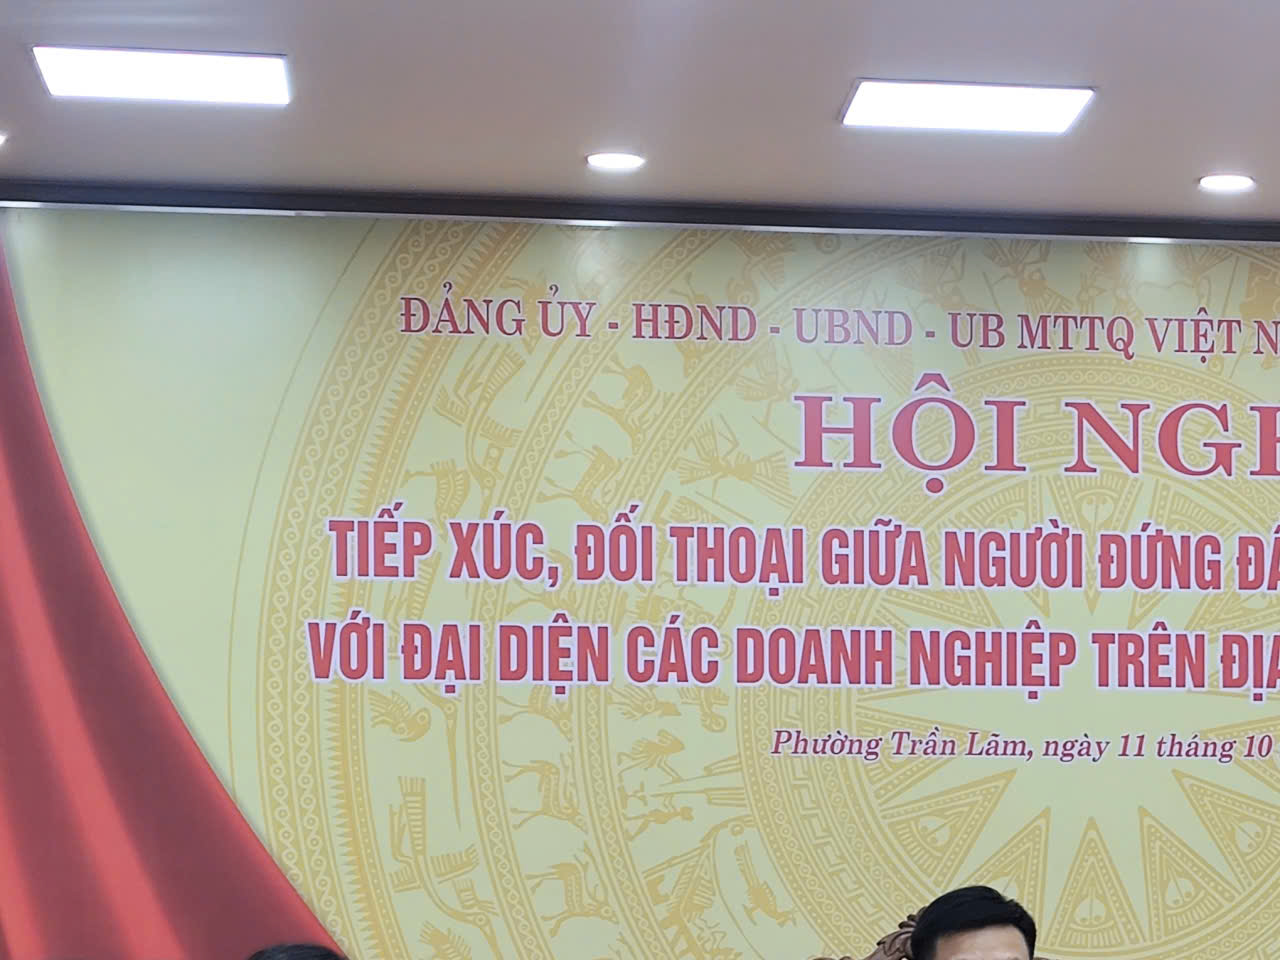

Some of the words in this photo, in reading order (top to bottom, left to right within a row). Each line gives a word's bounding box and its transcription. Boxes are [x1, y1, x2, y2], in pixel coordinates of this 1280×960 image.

[400, 284, 525, 338] ĐẢNG
[538, 285, 597, 339] ỦY
[632, 303, 759, 343] HĐND
[792, 308, 914, 347] UBND
[948, 312, 1006, 350] UB
[1017, 314, 1136, 360] MTTQ
[1144, 307, 1242, 364] VIỆT
[793, 372, 1026, 495] HỘI
[328, 502, 432, 578] TIẾP
[448, 511, 559, 588] XÚC,
[574, 504, 655, 583] ĐỐI
[670, 526, 802, 597] THOẠI
[821, 520, 927, 587] GIỮA
[944, 518, 1082, 589] NGƯỜI
[1098, 521, 1221, 591] ĐỨNG
[308, 610, 385, 680] VỚI
[401, 622, 480, 694] ĐẠI
[500, 615, 609, 695] DIỆN
[626, 615, 719, 686] CÁC
[737, 627, 892, 686] DOANH
[910, 620, 1076, 699] NGHIỆP
[1091, 621, 1205, 690] TRÊN
[771, 730, 882, 761] Phường
[891, 727, 958, 757] Trần
[966, 733, 1034, 763] Lãm,
[1042, 736, 1111, 762] ngày
[1118, 735, 1146, 758] 11
[1156, 734, 1235, 763] tháng
[1242, 735, 1273, 759] 10
